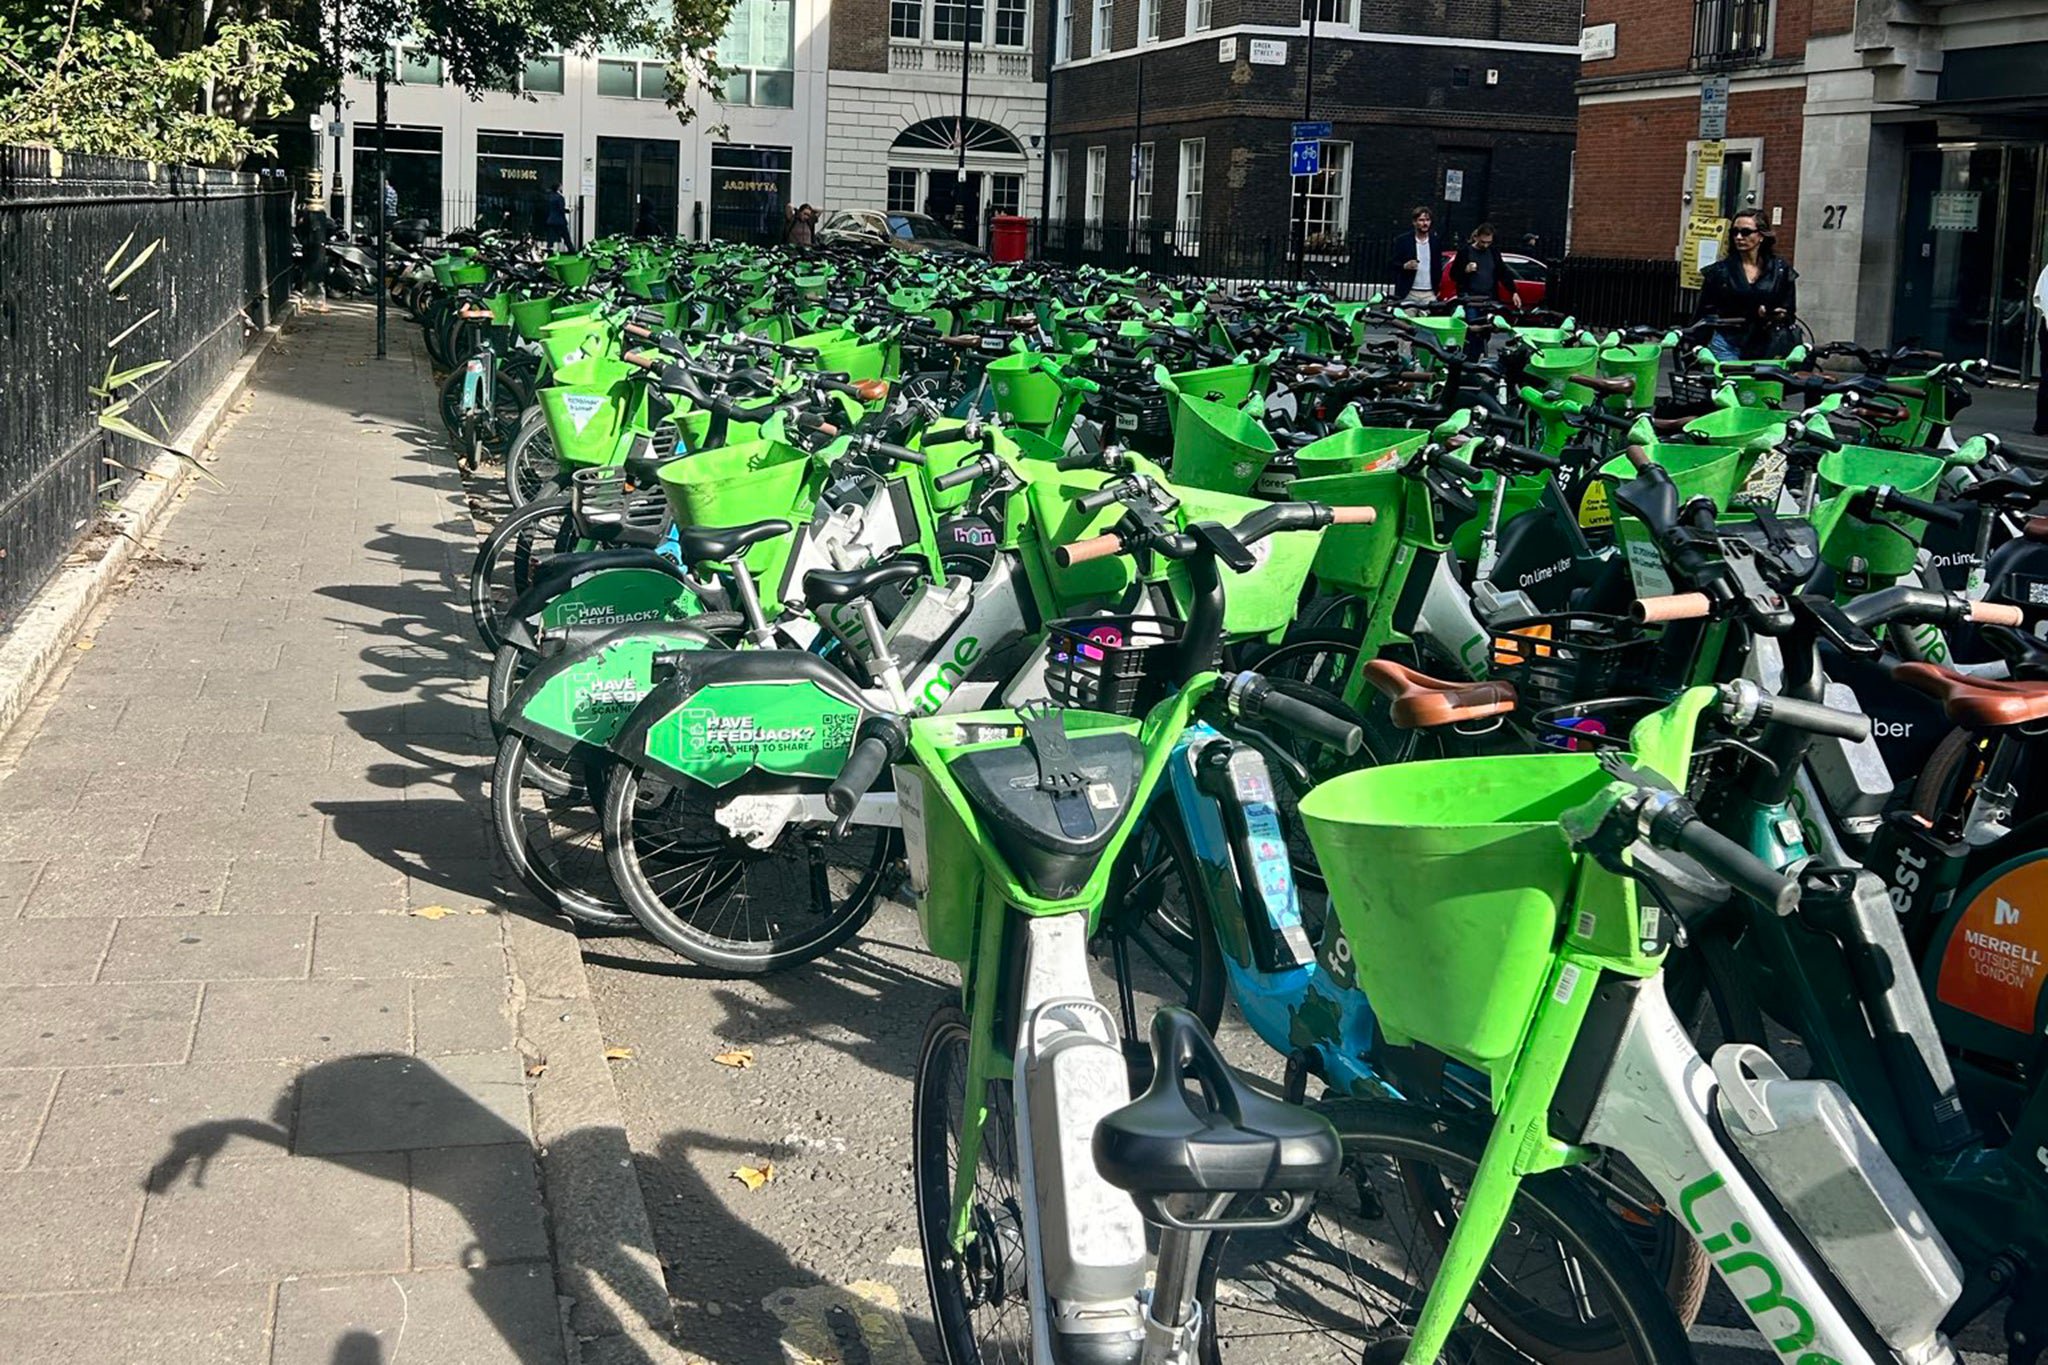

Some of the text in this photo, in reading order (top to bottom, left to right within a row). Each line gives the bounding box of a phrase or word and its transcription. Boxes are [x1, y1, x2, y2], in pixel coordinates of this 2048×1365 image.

[1823, 205, 1847, 229] 27
[1261, 478, 1289, 489] fores
[1933, 555, 1950, 567] On
[1519, 574, 1534, 587] On
[1533, 567, 1553, 583] Lime
[579, 605, 615, 618] HAVE
[591, 680, 636, 692] HAVE
[591, 706, 618, 715] SCAN
[706, 716, 754, 730] HAVE
[1873, 717, 1914, 738] ber
[763, 743, 775, 752] TO
[1964, 930, 2042, 965] MERRELL
[1968, 947, 2034, 978] OUTSIDE IN
[1975, 962, 2025, 988] LONDON
